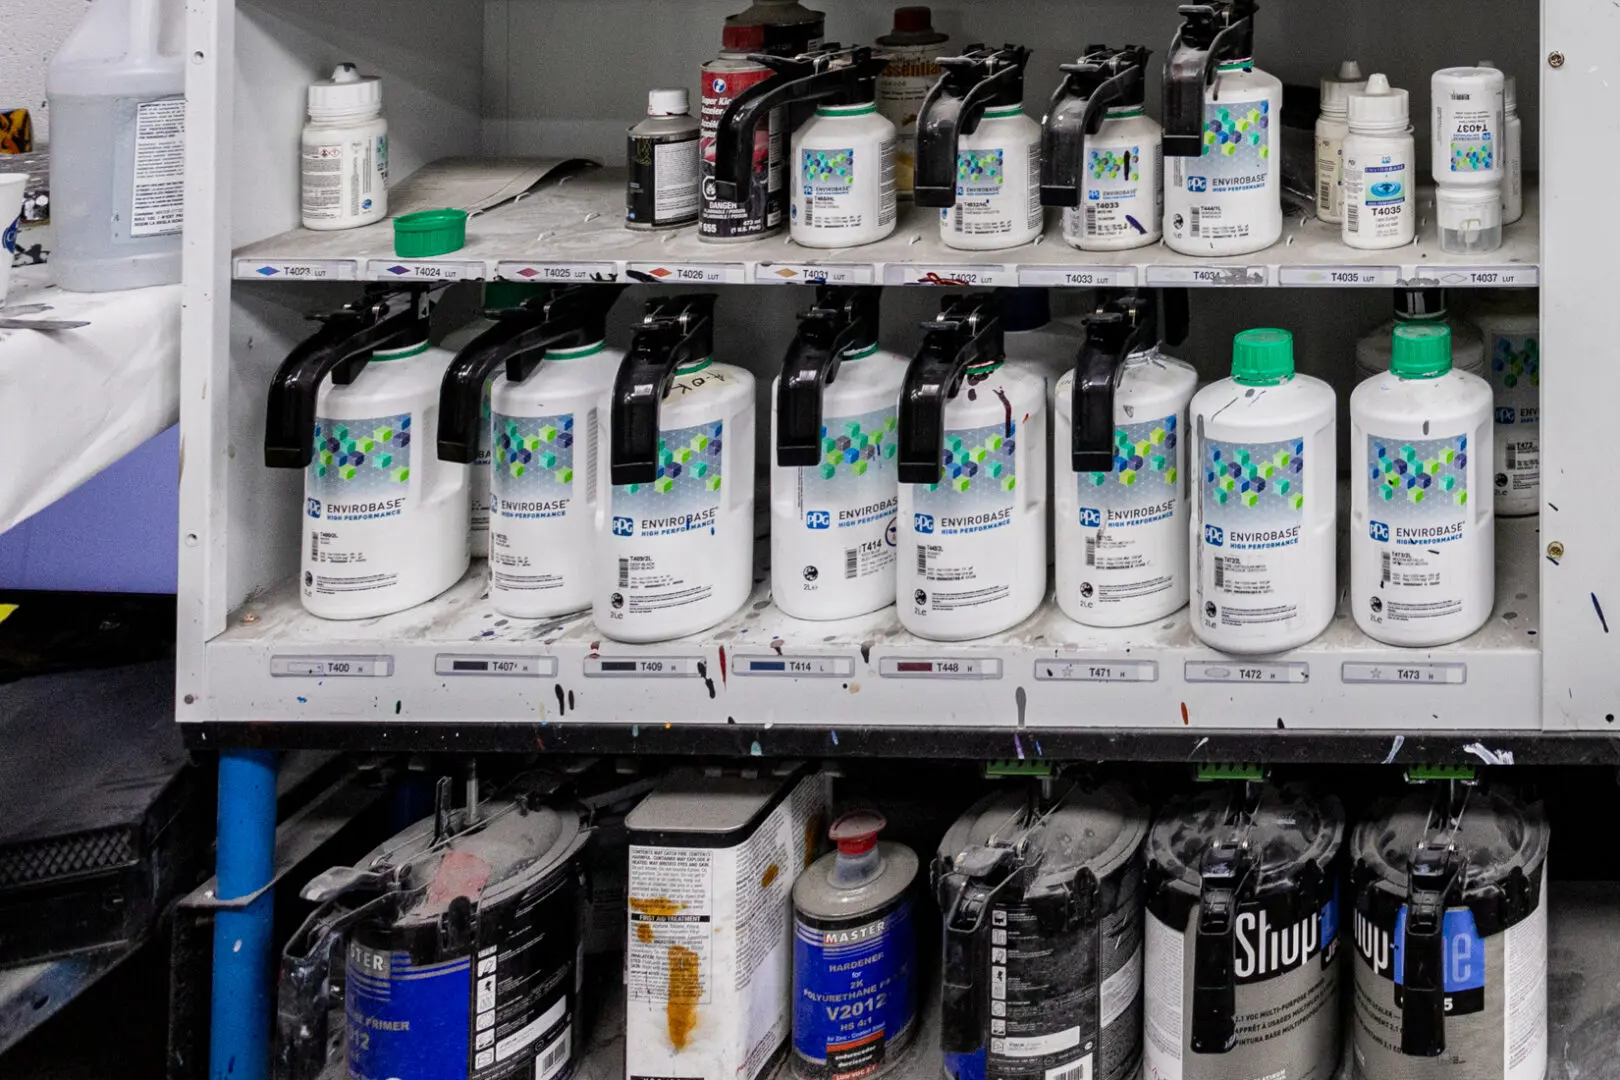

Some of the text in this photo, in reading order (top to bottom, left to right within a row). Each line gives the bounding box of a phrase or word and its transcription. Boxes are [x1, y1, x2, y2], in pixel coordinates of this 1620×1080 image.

[1371, 206, 1402, 216] T4035
[284, 266, 311, 276] T4023
[414, 265, 440, 277] T4024
[544, 269, 571, 278] T4025
[677, 270, 704, 279] T4026
[1065, 274, 1092, 284] T4033
[1331, 273, 1358, 282] T4035
[1470, 273, 1498, 282] T4037
[862, 538, 882, 552] T414
[328, 663, 350, 672] T400
[492, 661, 514, 671] T407
[640, 662, 663, 671] T409
[789, 661, 811, 671] T414
[936, 662, 959, 672] T448
[1089, 667, 1110, 677] T471
[1240, 669, 1261, 679] T472
[1398, 669, 1420, 679] T473
[825, 921, 885, 944] MASTER
[829, 952, 884, 972] HARDENER
[852, 971, 862, 979] for
[850, 980, 864, 989] 2K
[826, 993, 888, 1021] V2012
[365, 1019, 410, 1031] PRIMER
[840, 1017, 872, 1031] HS 4:1
